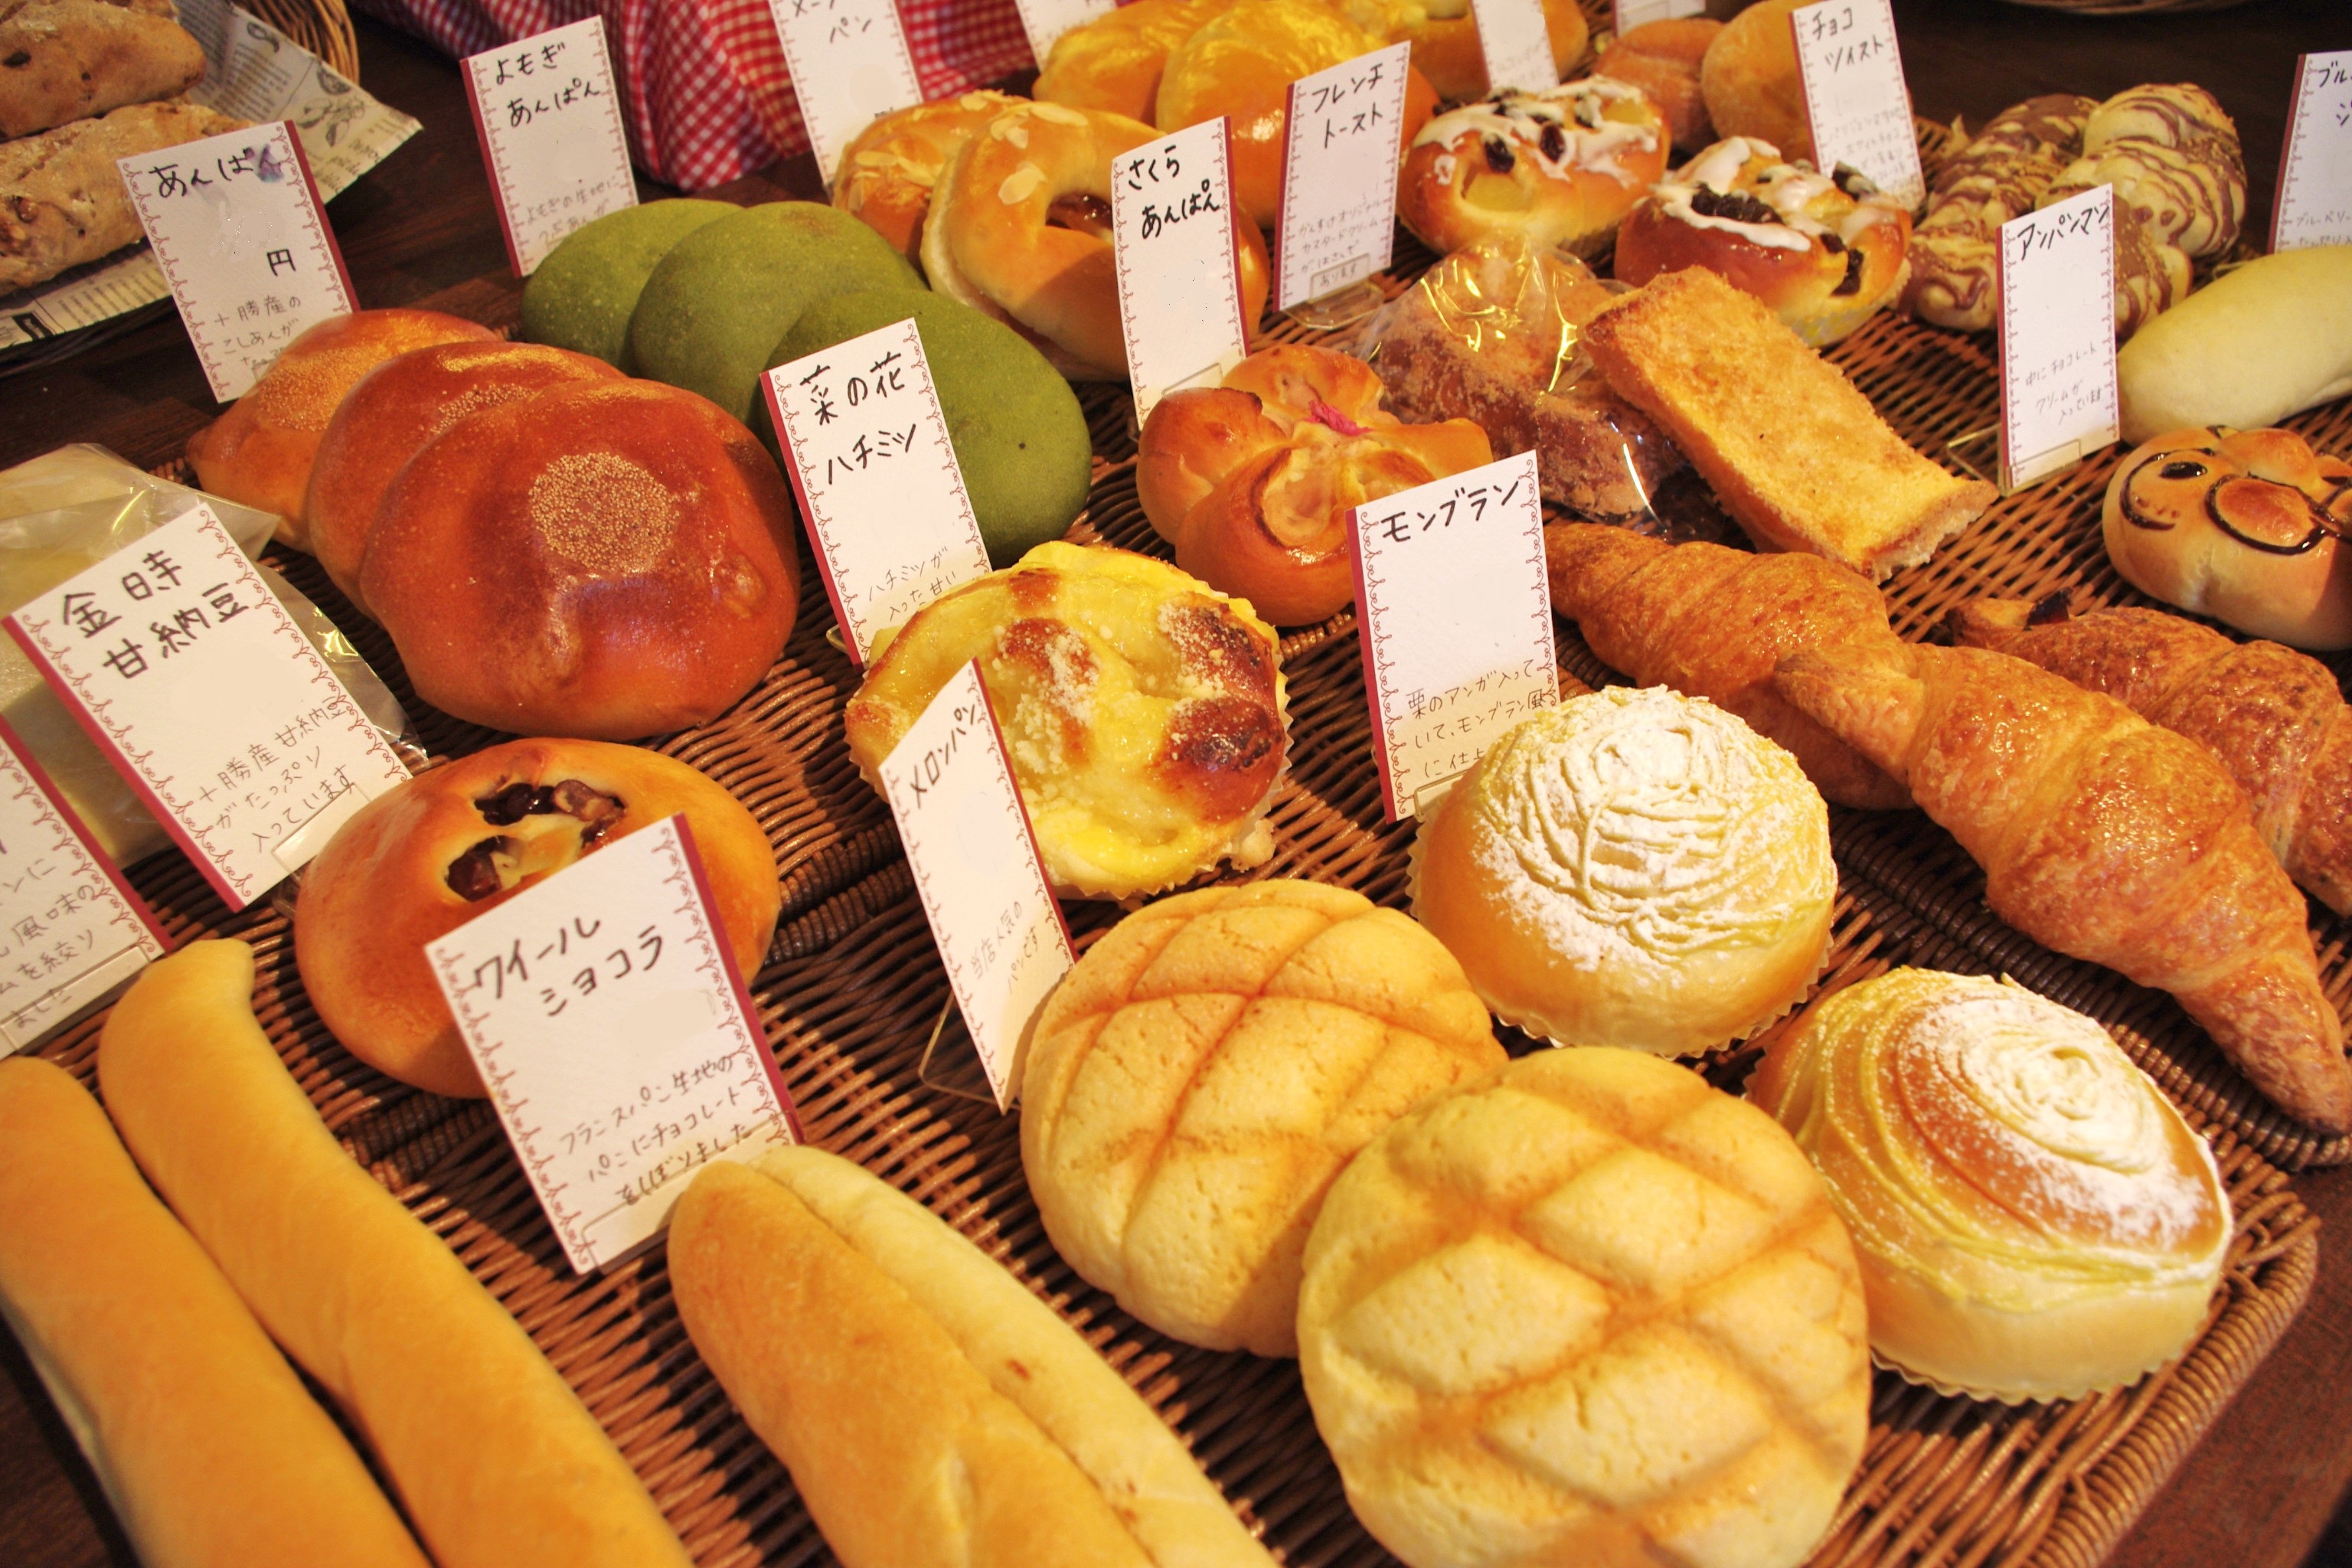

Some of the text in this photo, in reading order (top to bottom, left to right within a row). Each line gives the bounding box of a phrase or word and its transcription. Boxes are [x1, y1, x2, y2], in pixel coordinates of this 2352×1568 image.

[829, 16, 872, 44] パン
[1811, 7, 1854, 41] チョコ
[495, 41, 566, 85] よもぎ
[1824, 34, 1885, 73] ツイスト
[507, 77, 600, 127] あんぱん
[1311, 62, 1383, 113] フレンチ
[1324, 102, 1383, 149] トースト
[1129, 144, 1181, 191] さくら
[1142, 178, 1220, 240] あんぱん
[2017, 206, 2110, 261] アンパンマン
[266, 248, 297, 277] 円
[214, 294, 302, 326] 十勝産の
[224, 317, 299, 354] こしあんが
[799, 351, 905, 426] 菜の花
[828, 423, 916, 485] ハチミツ
[1380, 479, 1519, 543] モンブラン
[61, 549, 182, 639] 金時
[868, 545, 949, 602] ハチミツが
[889, 570, 956, 622] 入った甘い
[103, 583, 250, 679] 甘納豆
[1406, 658, 1535, 720] 栗のアンが入って
[910, 703, 976, 810] メロンパン
[216, 745, 322, 829] がたっぷり
[251, 763, 354, 854] 入っています
[539, 924, 665, 1018] ショコラ
